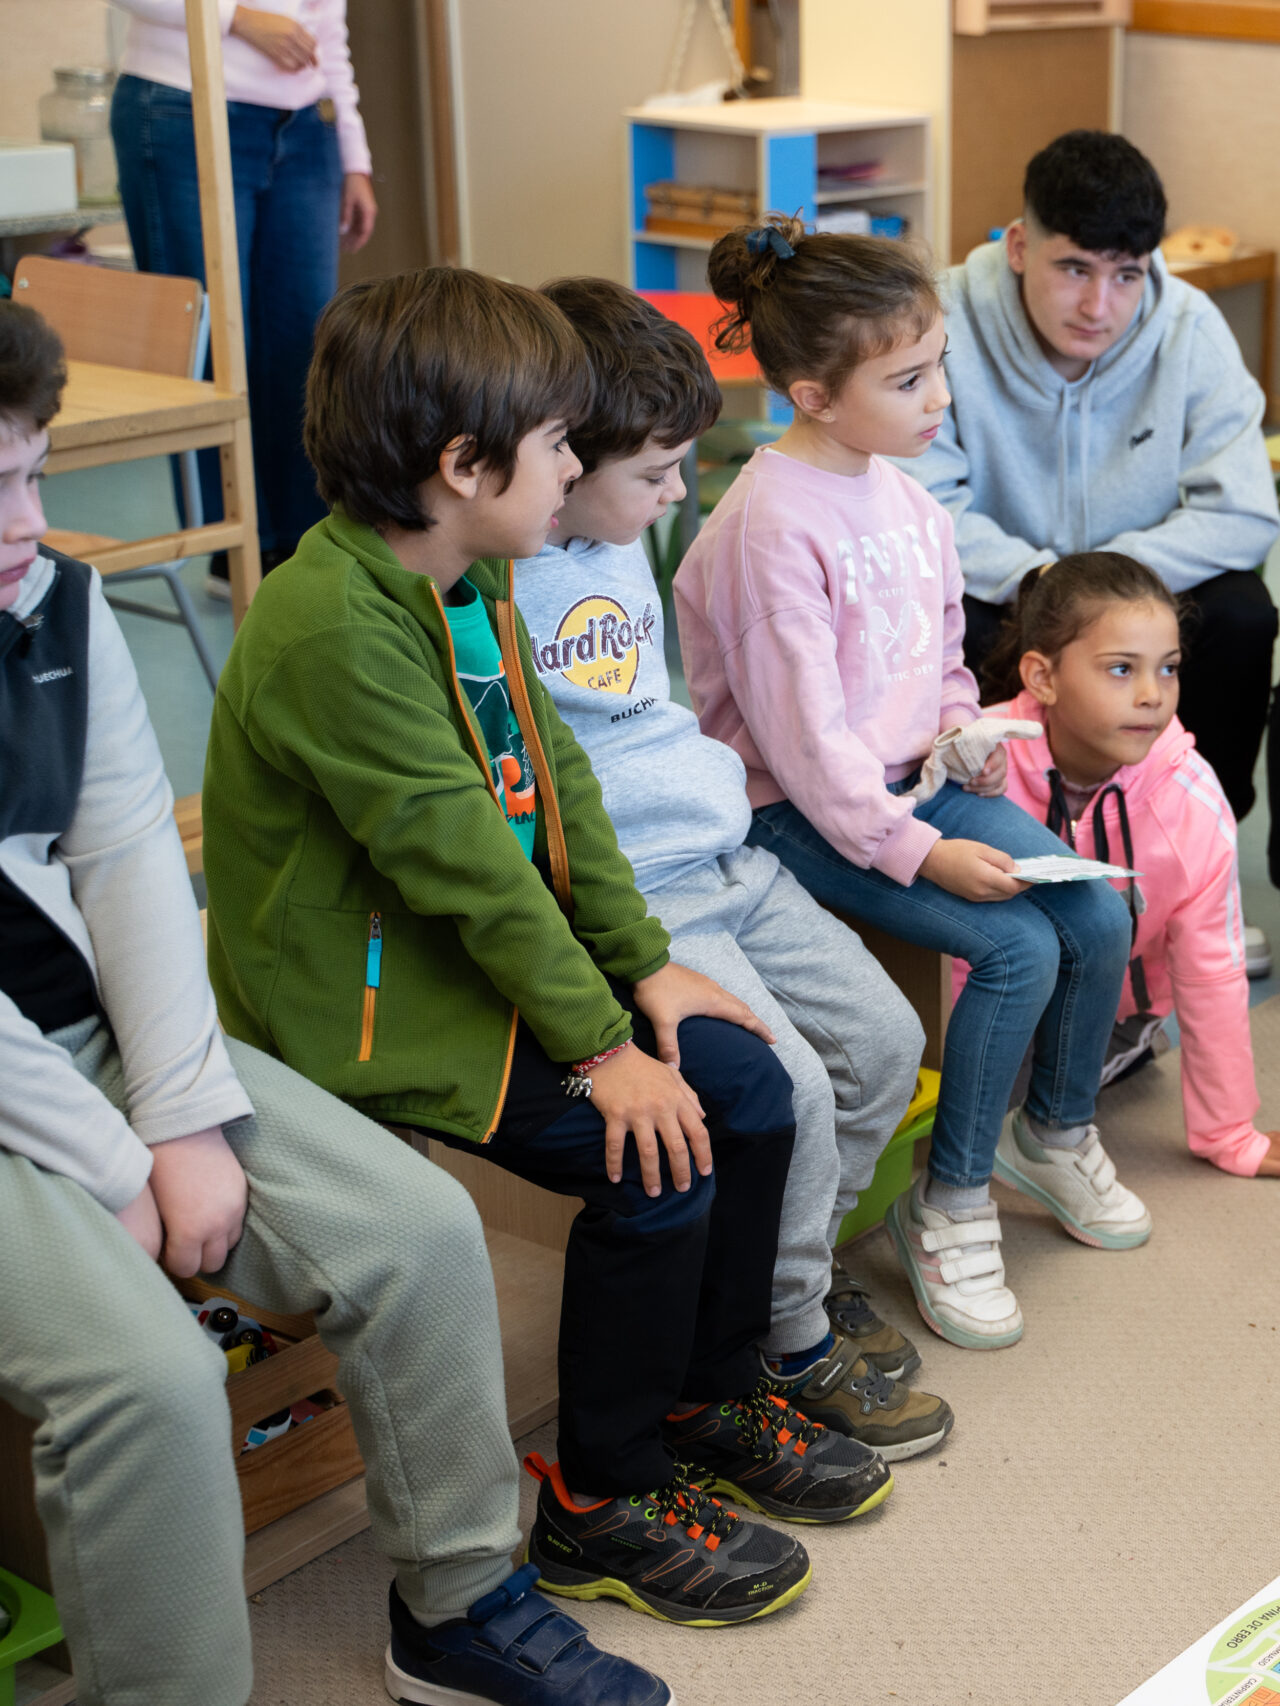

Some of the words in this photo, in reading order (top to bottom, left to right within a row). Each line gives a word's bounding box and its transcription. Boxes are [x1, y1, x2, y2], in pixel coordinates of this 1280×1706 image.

[599, 603, 655, 660] Rock
[588, 668, 622, 691] CAFE
[1246, 1619, 1264, 1631] DE
[1226, 1629, 1252, 1649] EBRO
